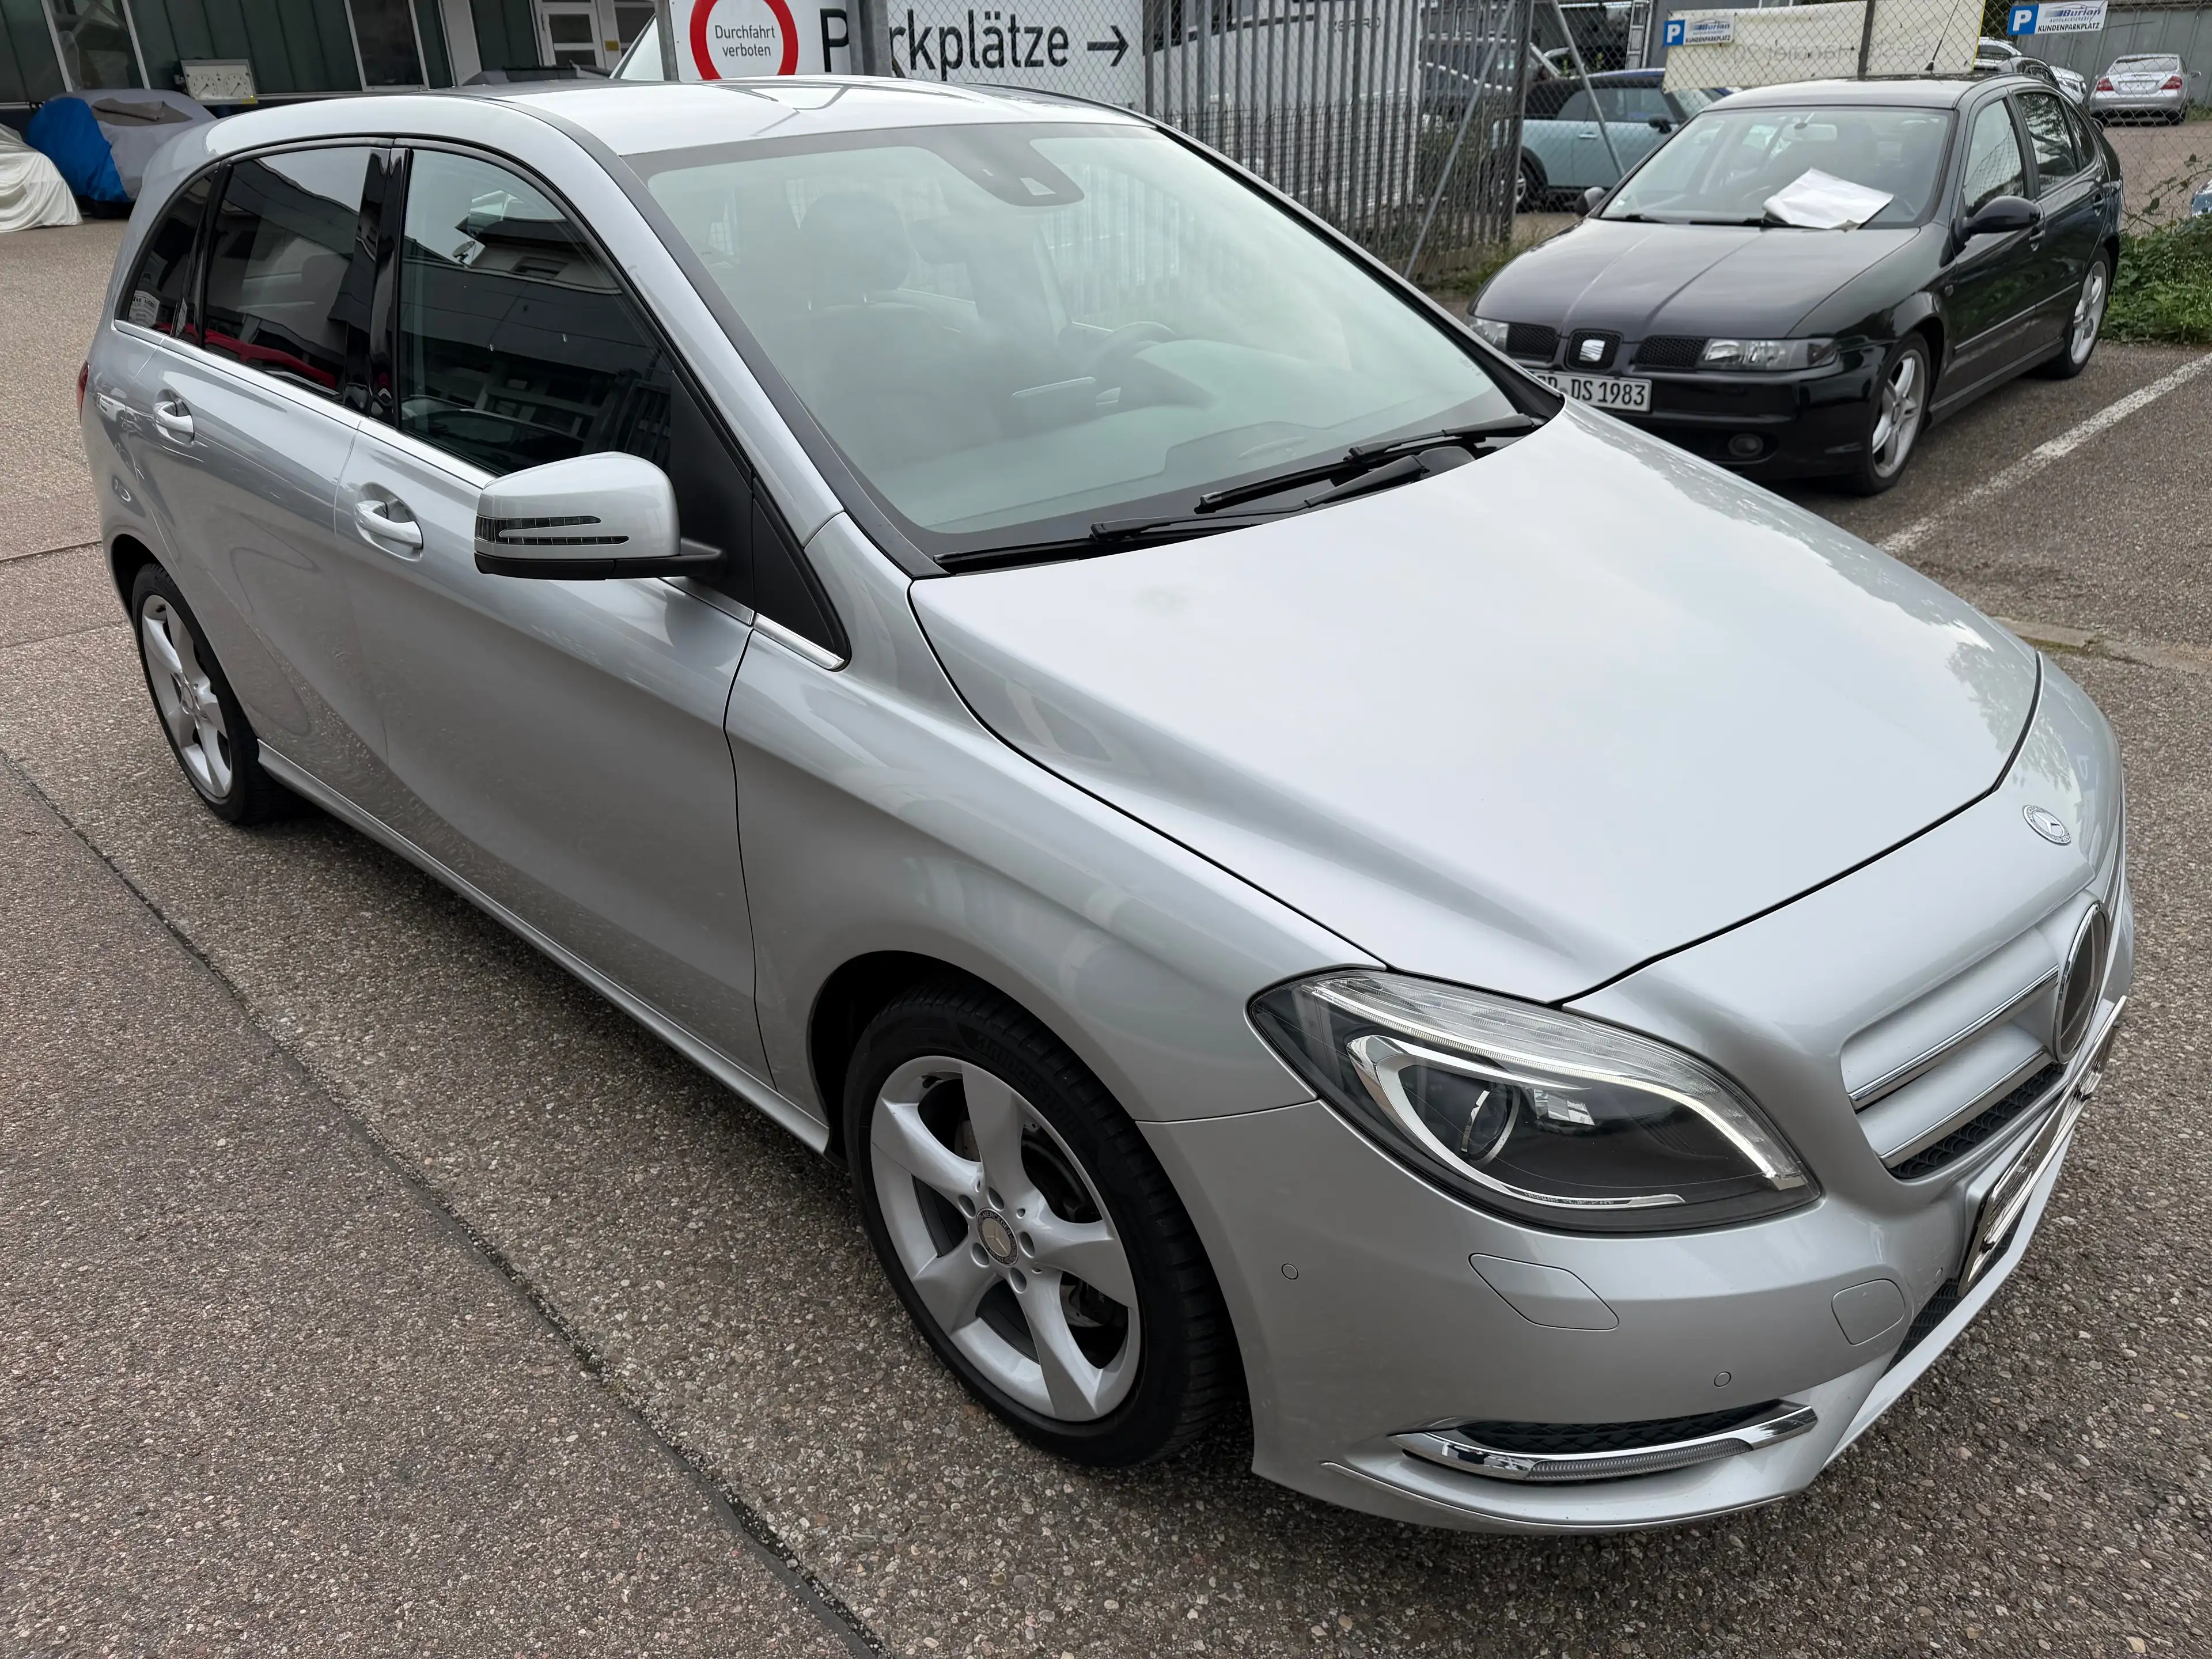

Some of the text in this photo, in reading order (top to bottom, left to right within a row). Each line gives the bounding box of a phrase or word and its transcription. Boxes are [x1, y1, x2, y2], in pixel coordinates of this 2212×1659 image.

[715, 24, 775, 39] Durchfahrt
[2037, 22, 2100, 32] KUNDENPARKPLATZ
[722, 42, 771, 56] verboten
[820, 7, 1069, 81] Prkplätze
[1571, 378, 1593, 401] DS
[1597, 381, 1645, 405] 1983
